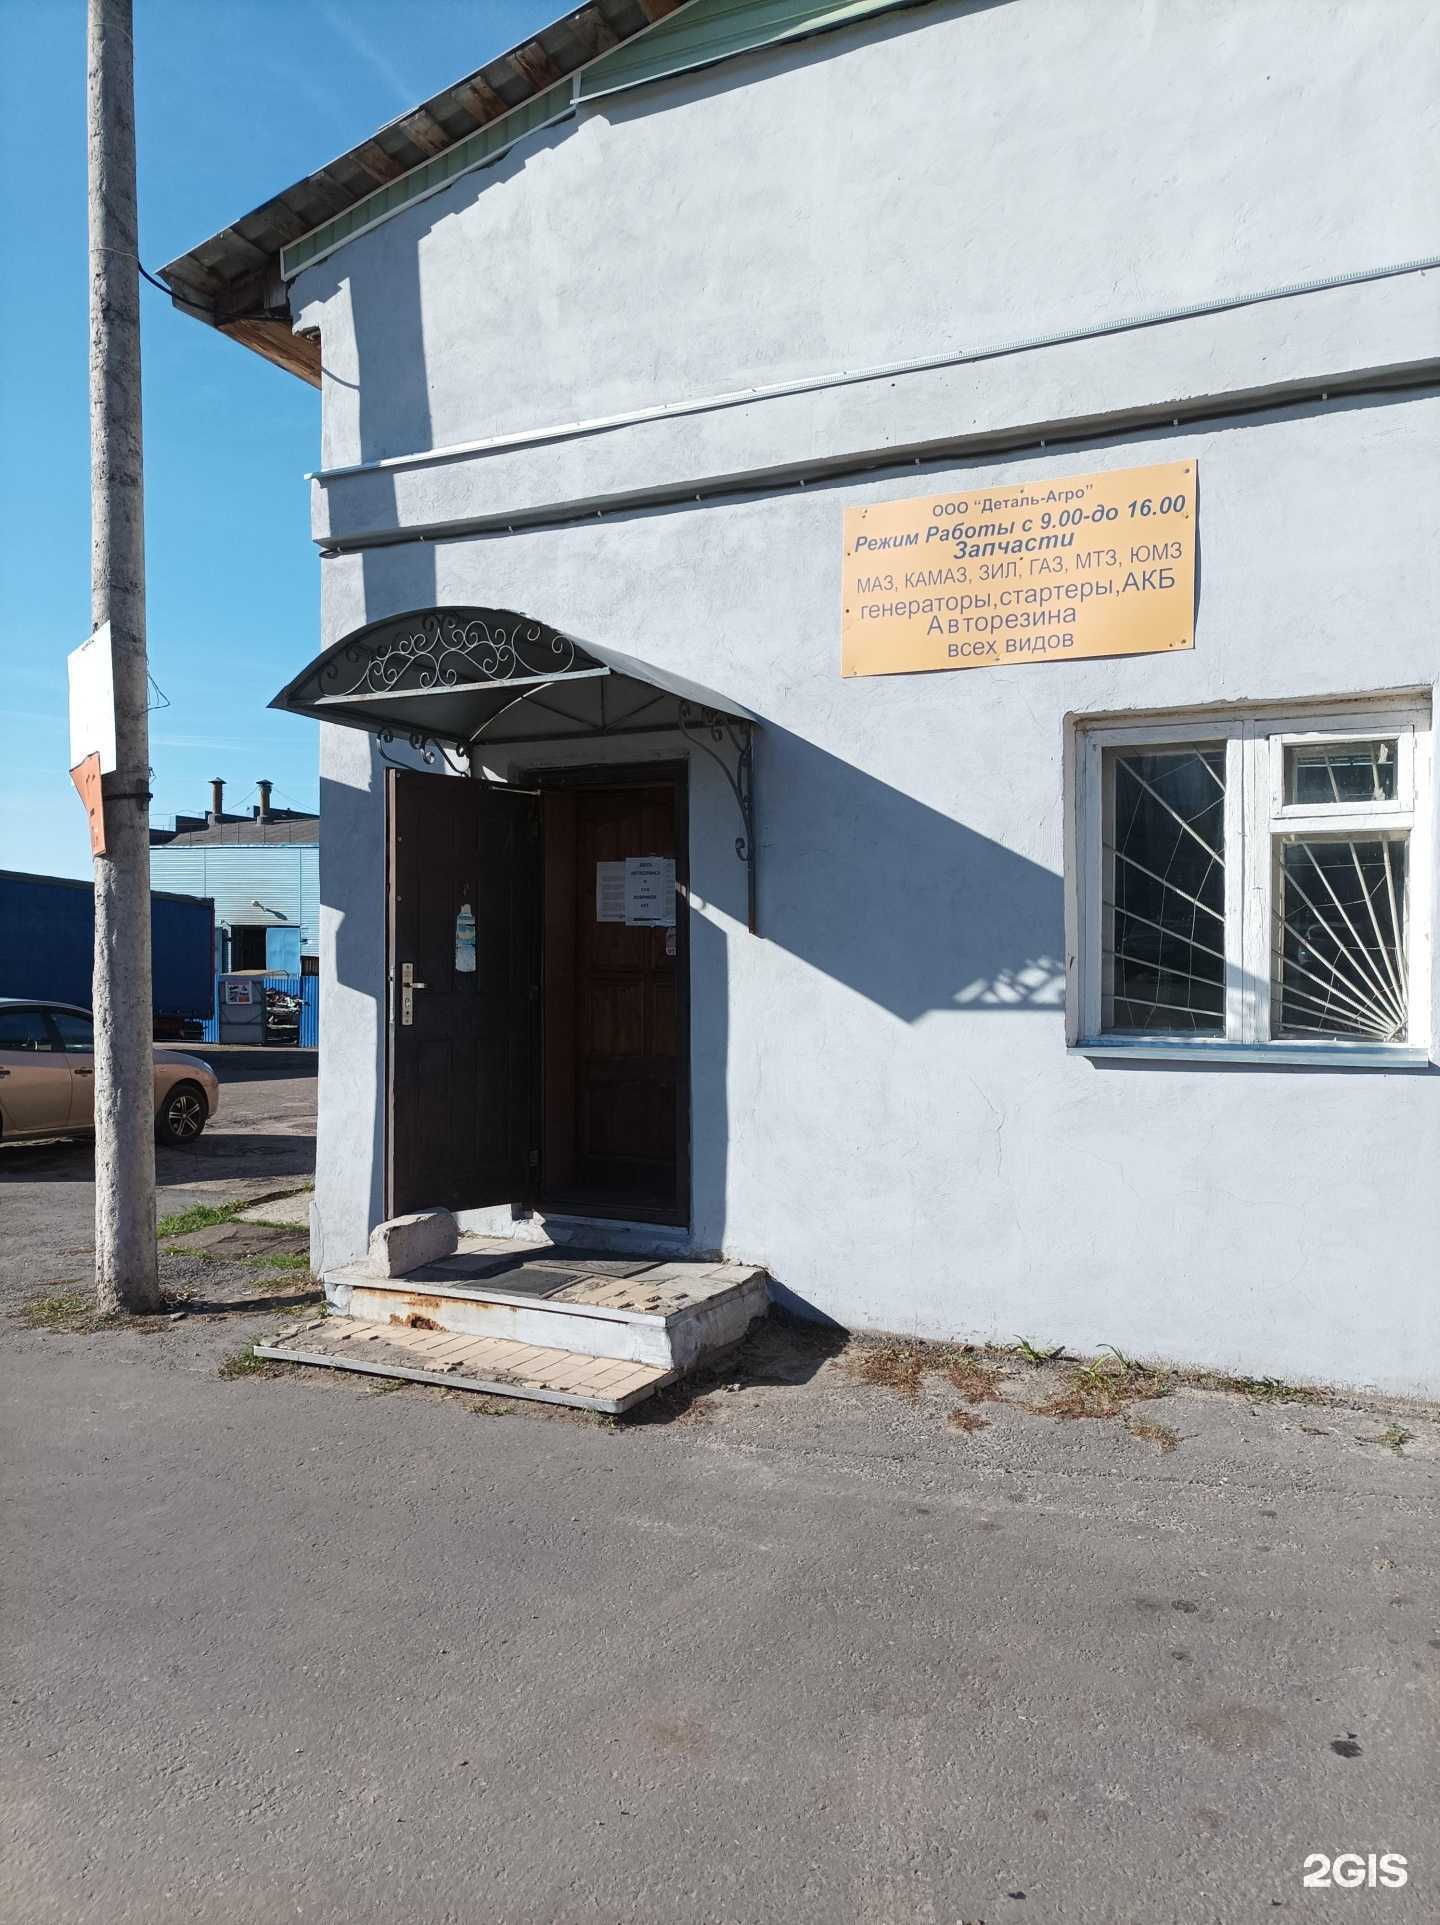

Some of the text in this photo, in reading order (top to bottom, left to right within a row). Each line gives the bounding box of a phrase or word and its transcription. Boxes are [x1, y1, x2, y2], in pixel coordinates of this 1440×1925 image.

[932, 501, 969, 517] ООО
[855, 532, 919, 552] Режим
[926, 519, 1015, 543] Работы
[1022, 518, 1032, 531] с
[1128, 495, 1185, 518] 16.00
[953, 531, 1074, 559] Запчасти
[857, 542, 1182, 594] МАЗ, КАМАЗ, ЗИЛ, ГАЗ, МТЗ, ЮМЗ
[948, 634, 1074, 657] всех видов
